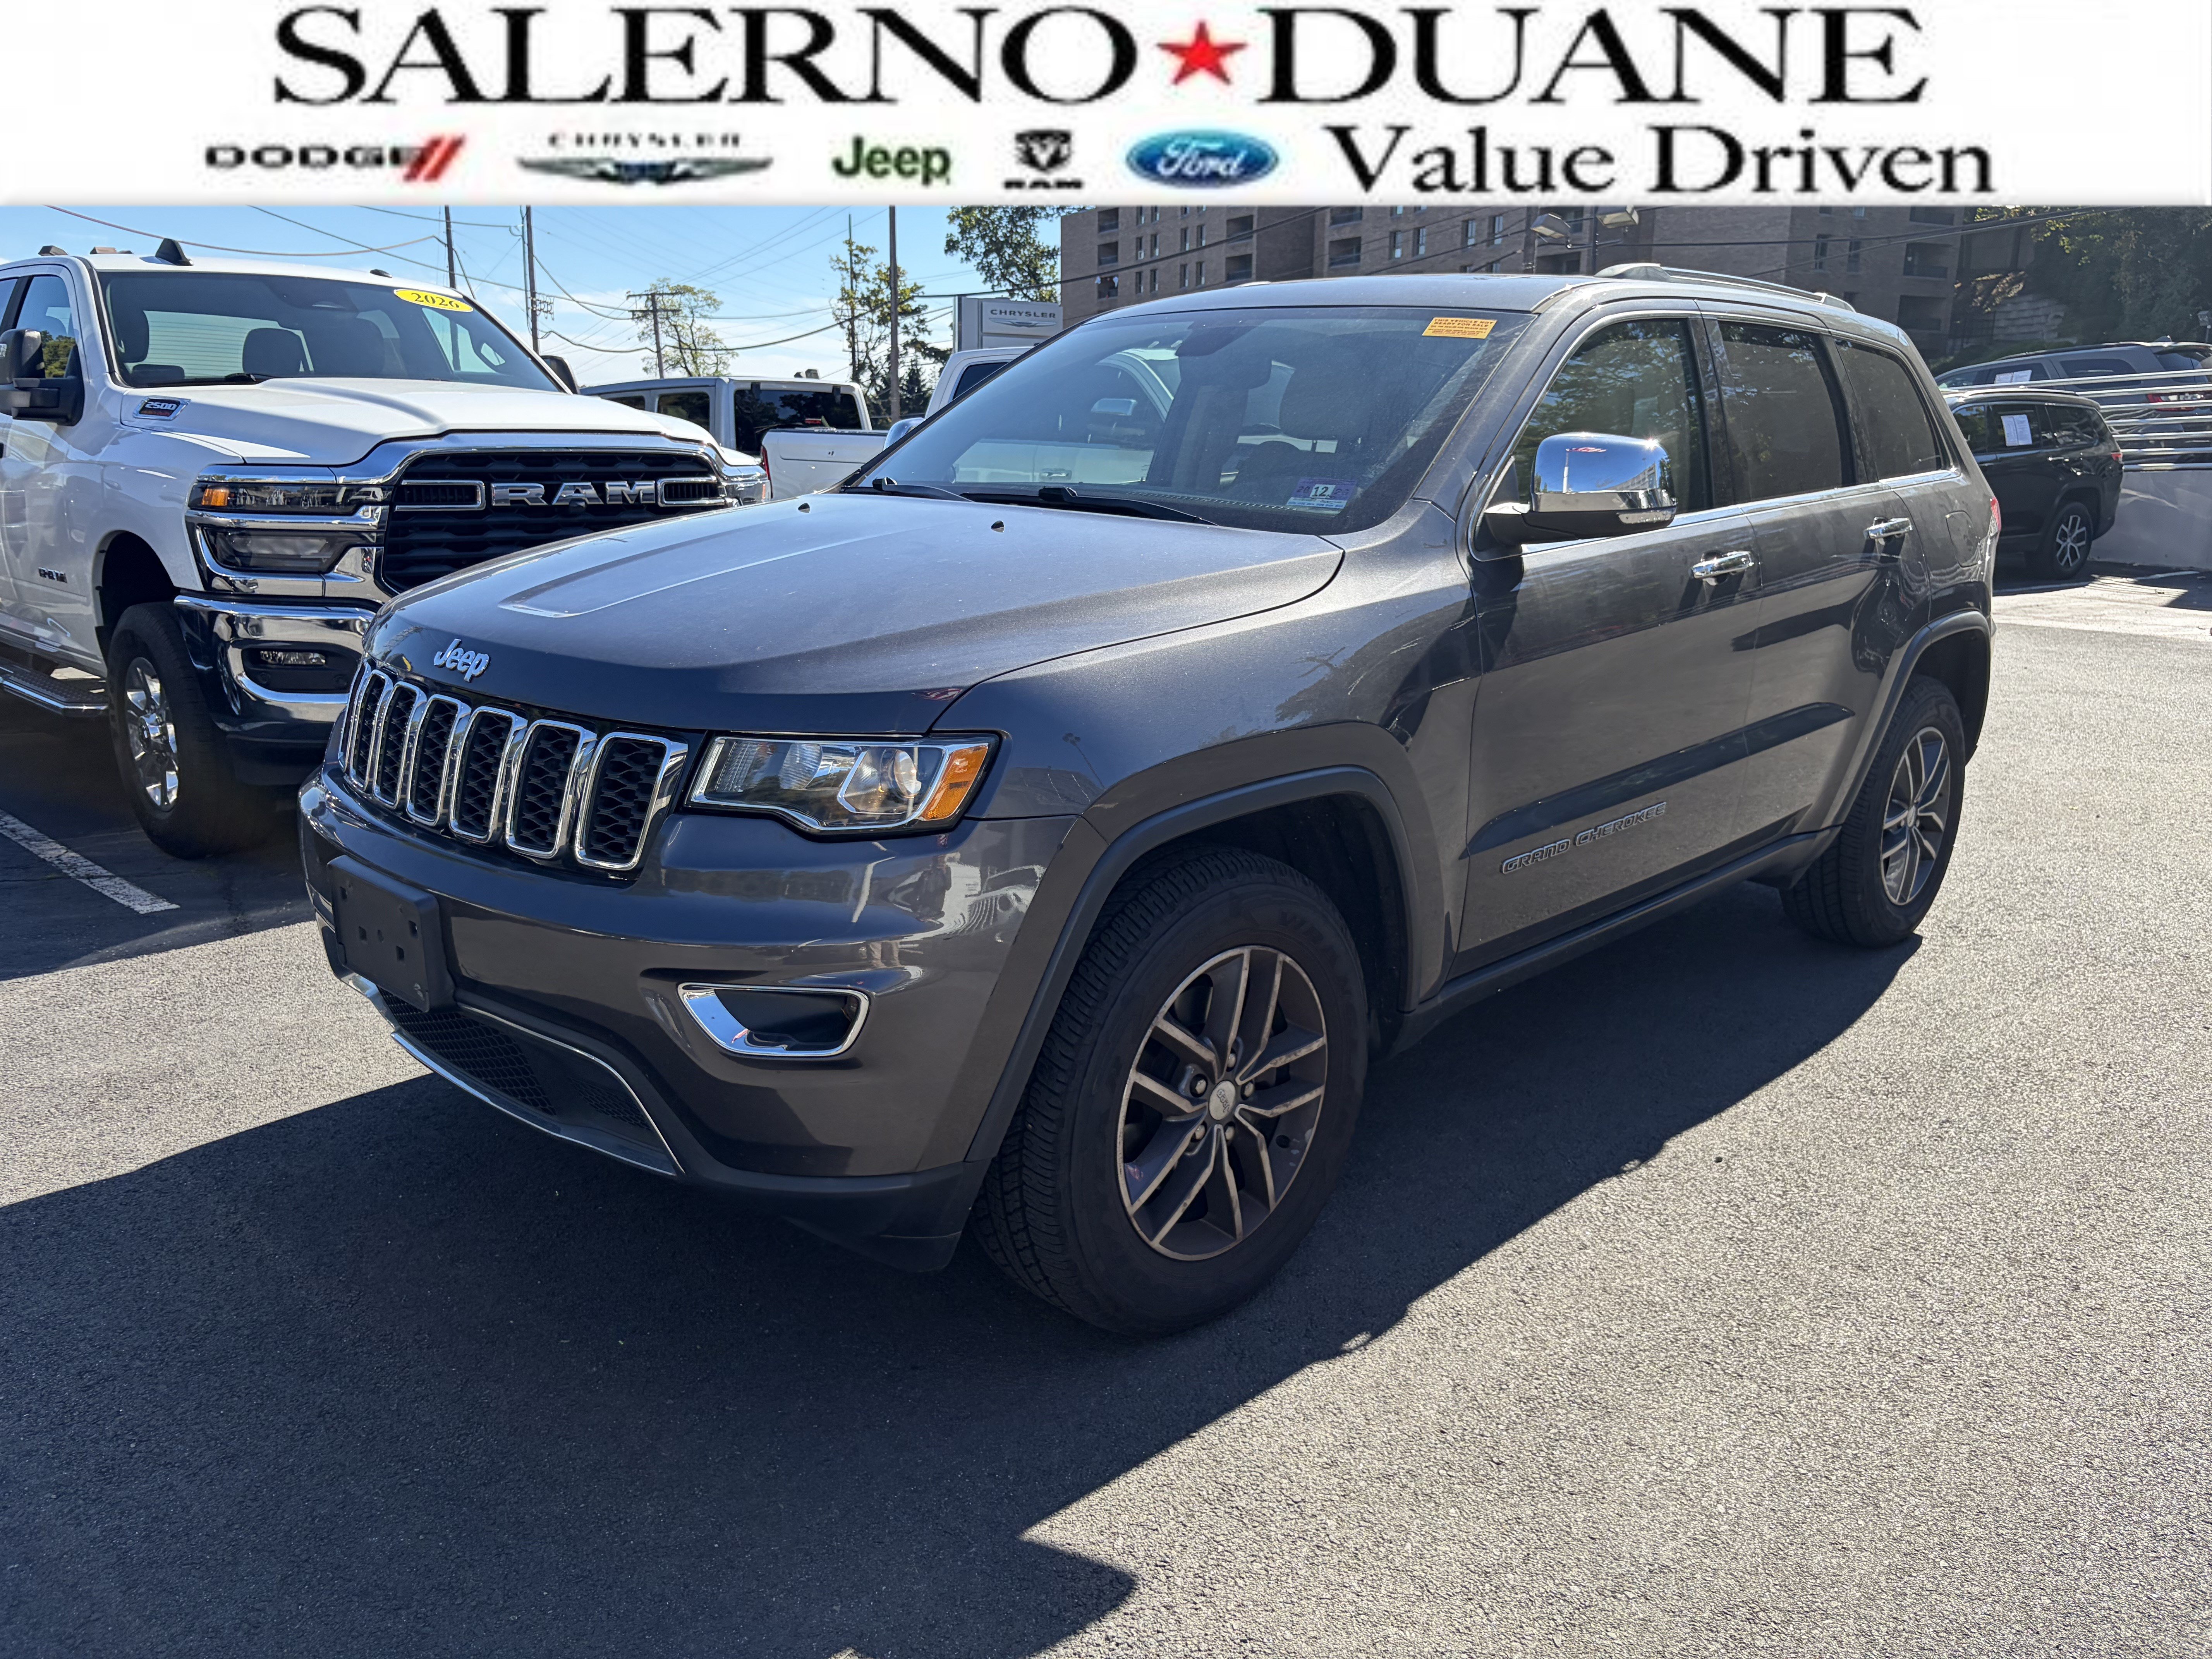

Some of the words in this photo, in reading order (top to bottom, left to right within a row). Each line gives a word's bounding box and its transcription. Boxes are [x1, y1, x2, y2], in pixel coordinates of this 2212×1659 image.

[411, 292, 460, 308] 2026
[990, 309, 1056, 319] CHRYSLER
[145, 401, 177, 410] 2500
[491, 481, 656, 506] RAM
[1312, 486, 1329, 497] 12
[434, 638, 490, 682] Jeep
[1501, 838, 1571, 874] GRAND
[1575, 801, 1666, 847] CHEROKEE
